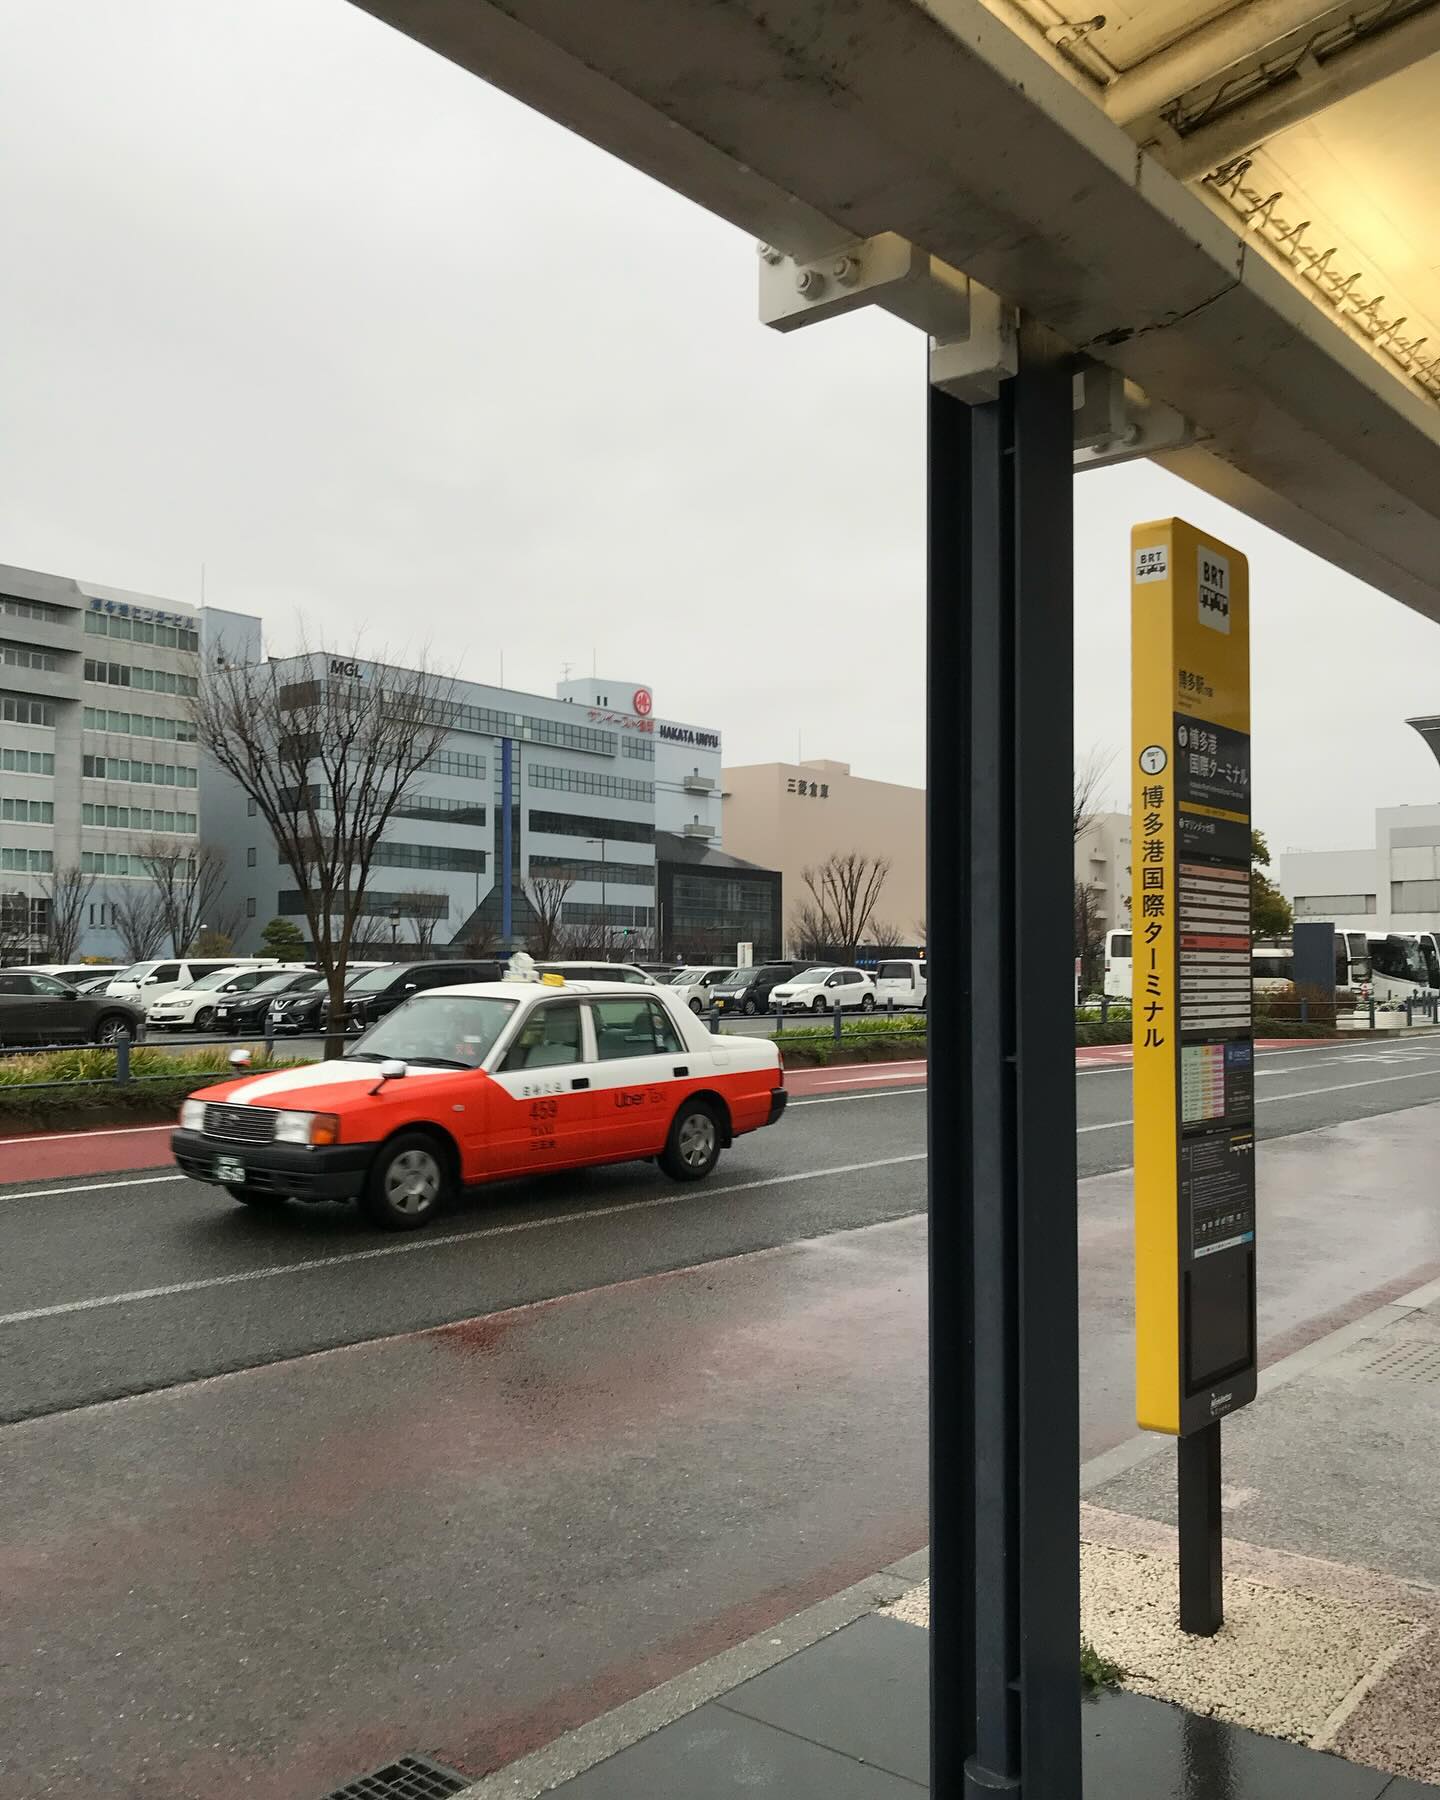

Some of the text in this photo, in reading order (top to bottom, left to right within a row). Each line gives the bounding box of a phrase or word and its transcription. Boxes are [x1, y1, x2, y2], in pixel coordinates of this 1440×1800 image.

[1140, 551, 1162, 564] BRT
[1203, 561, 1224, 589] BRT
[330, 659, 363, 679] MGL
[660, 725, 694, 744] HAKATA
[1189, 727, 1217, 755] 博多港
[1150, 758, 1156, 770] 1
[1189, 753, 1249, 784] 国際ターミナル
[1142, 784, 1165, 1048] 博多港国際ターミナル
[614, 1092, 646, 1108] Uber
